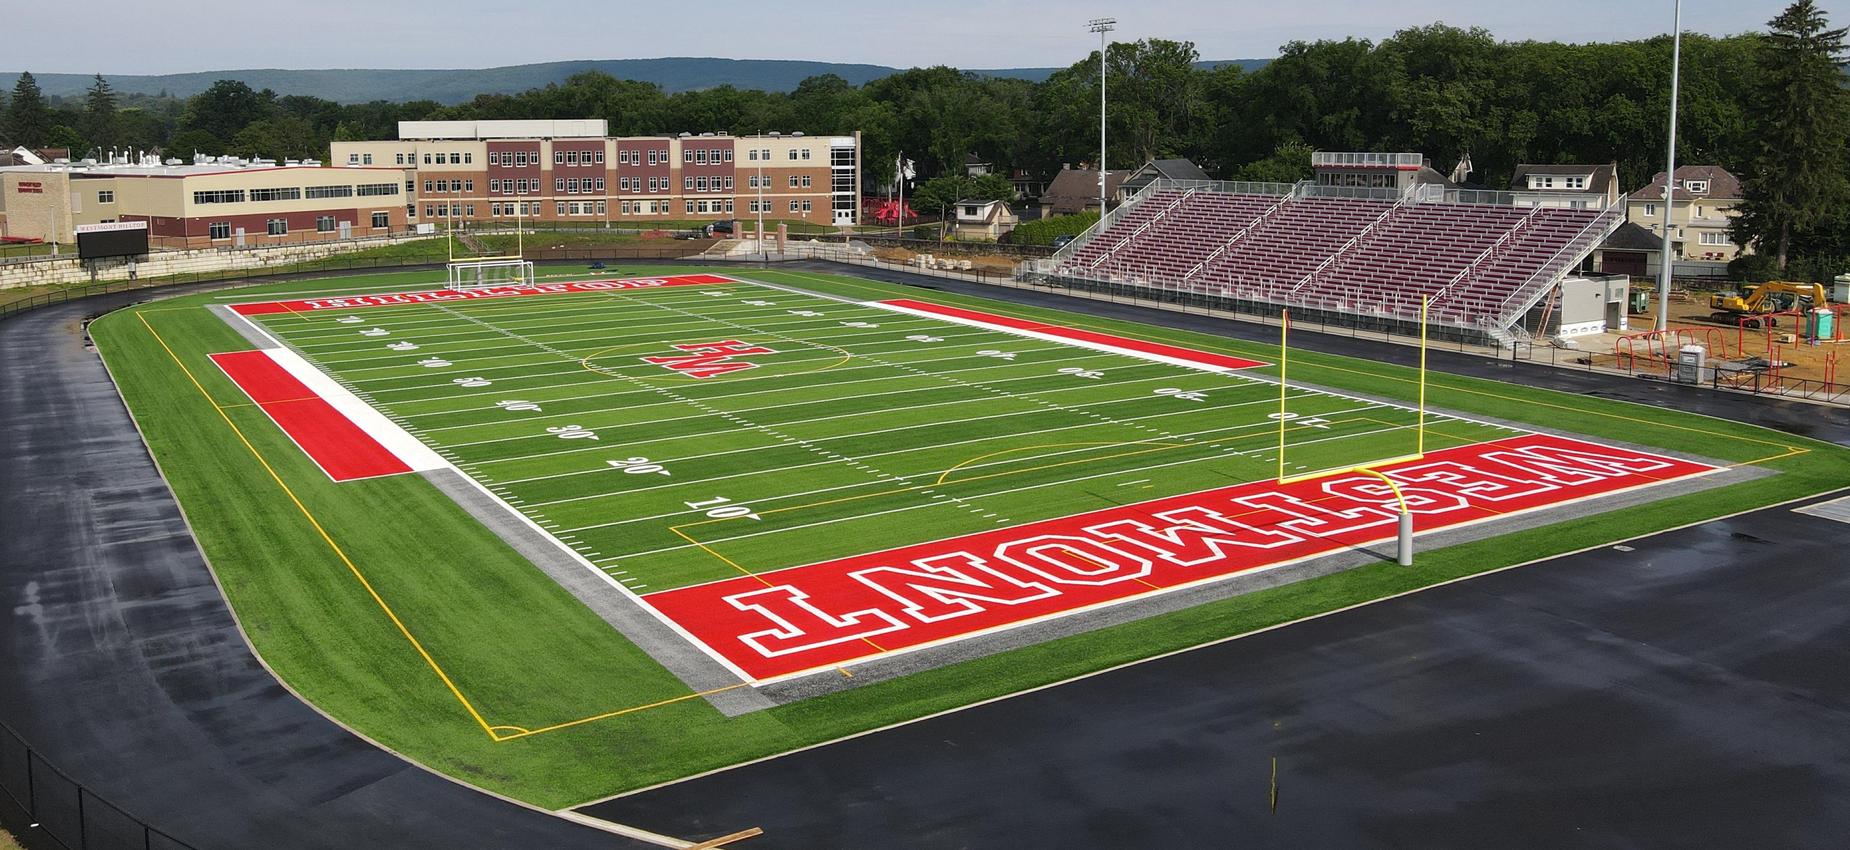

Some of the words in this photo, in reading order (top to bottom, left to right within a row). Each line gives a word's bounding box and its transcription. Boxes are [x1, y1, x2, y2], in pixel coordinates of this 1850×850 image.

[545, 424, 596, 440] 30
[606, 456, 664, 475] 20
[683, 496, 752, 519] 10
[722, 444, 1674, 658] WESTMONT
